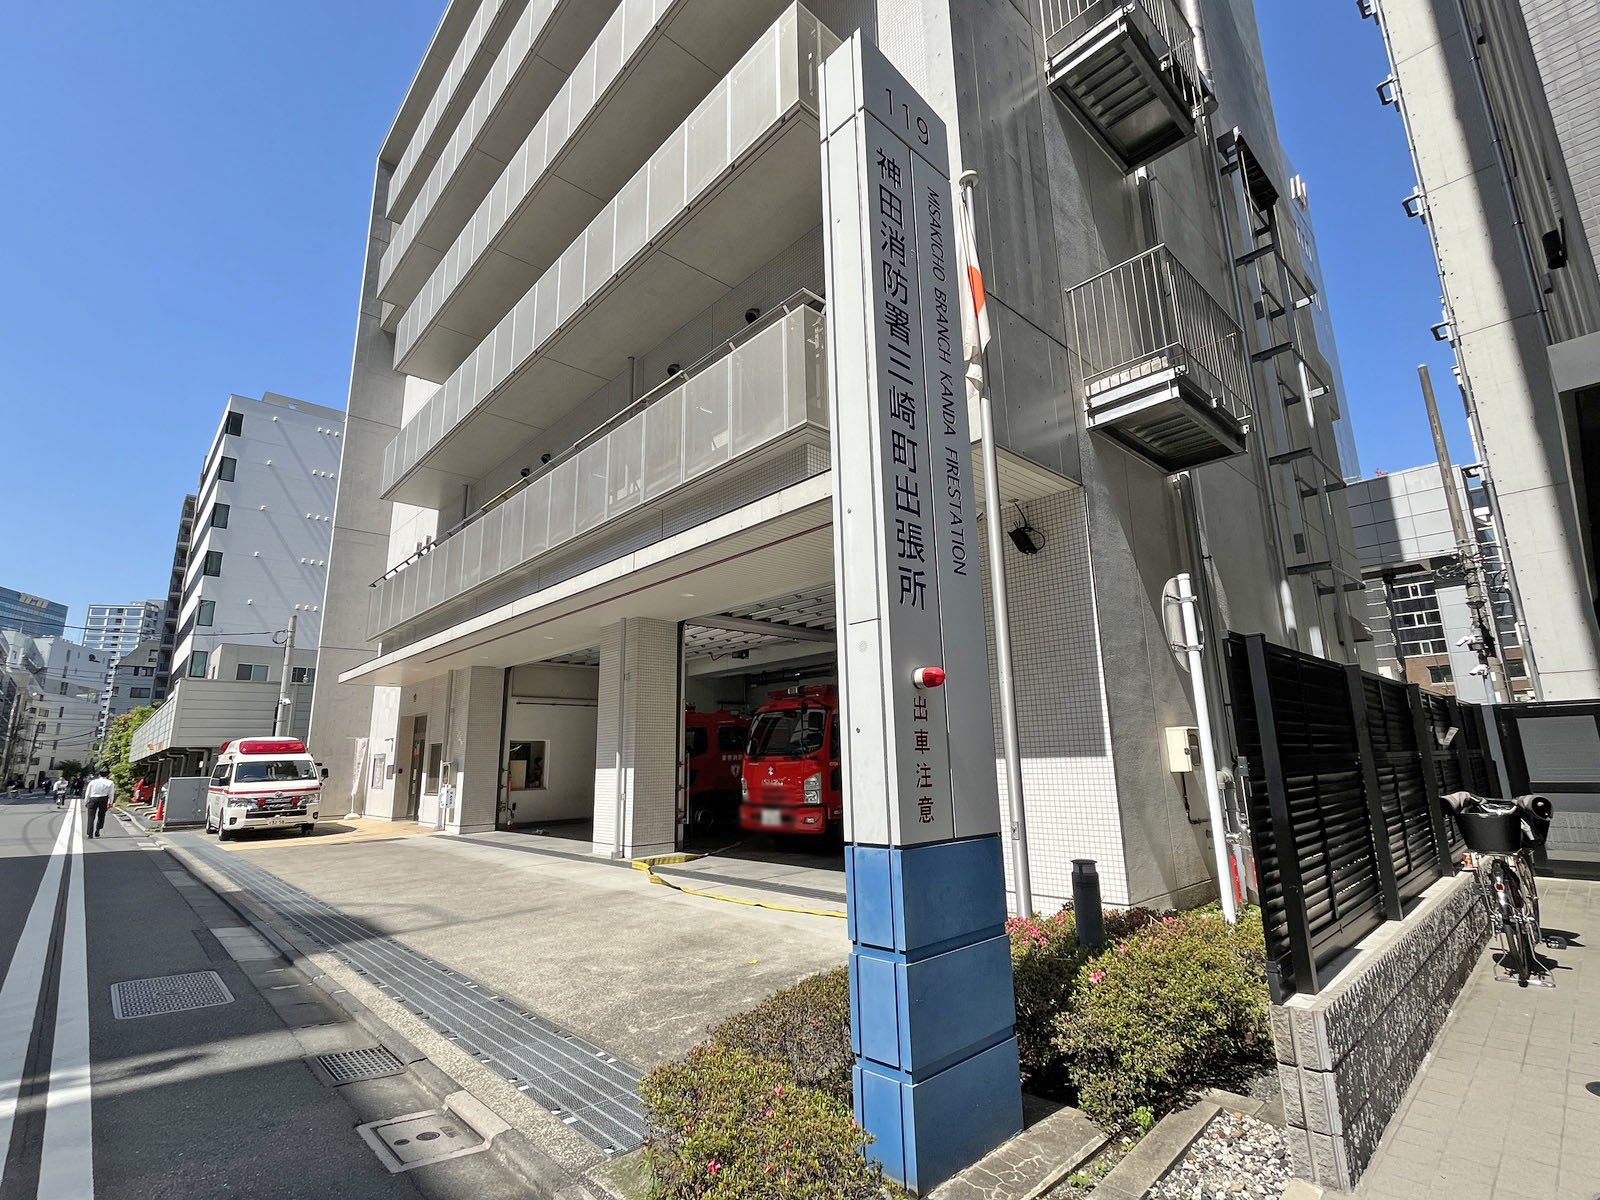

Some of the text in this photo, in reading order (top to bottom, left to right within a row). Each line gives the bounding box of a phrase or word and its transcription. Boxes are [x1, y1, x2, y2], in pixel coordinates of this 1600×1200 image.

[885, 88, 930, 145] 119
[876, 146, 926, 610] 神田消防署三崎町出張所
[927, 186, 967, 576] MISAKICHO BRANCH KANDA FIRESTATION
[913, 695, 935, 823] 出車注意
